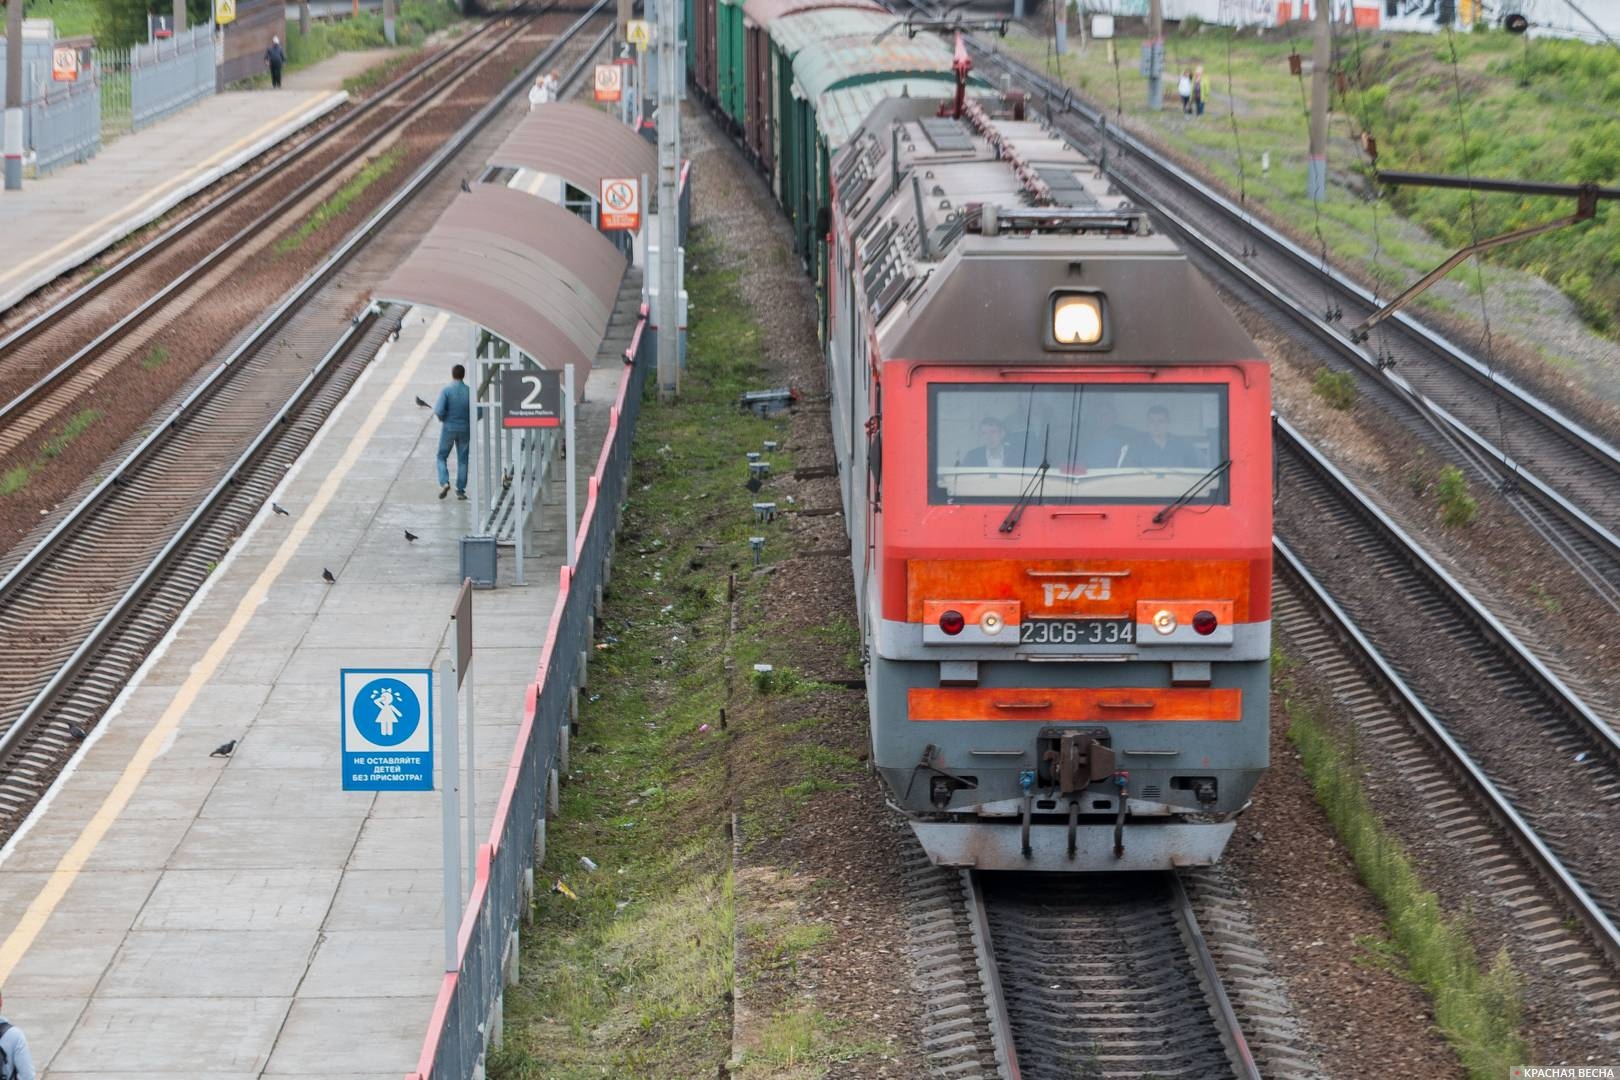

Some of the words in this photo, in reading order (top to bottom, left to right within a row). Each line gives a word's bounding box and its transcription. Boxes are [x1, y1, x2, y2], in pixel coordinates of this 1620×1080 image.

[520, 375, 543, 410] 2
[353, 757, 365, 765] НЕ
[366, 755, 421, 765] ОСТАВЛЯЙТЕ
[373, 765, 401, 774] ДЕТЕЙ
[352, 774, 368, 782] БЕЗ
[370, 774, 423, 782] ПРИСМОТРА!
